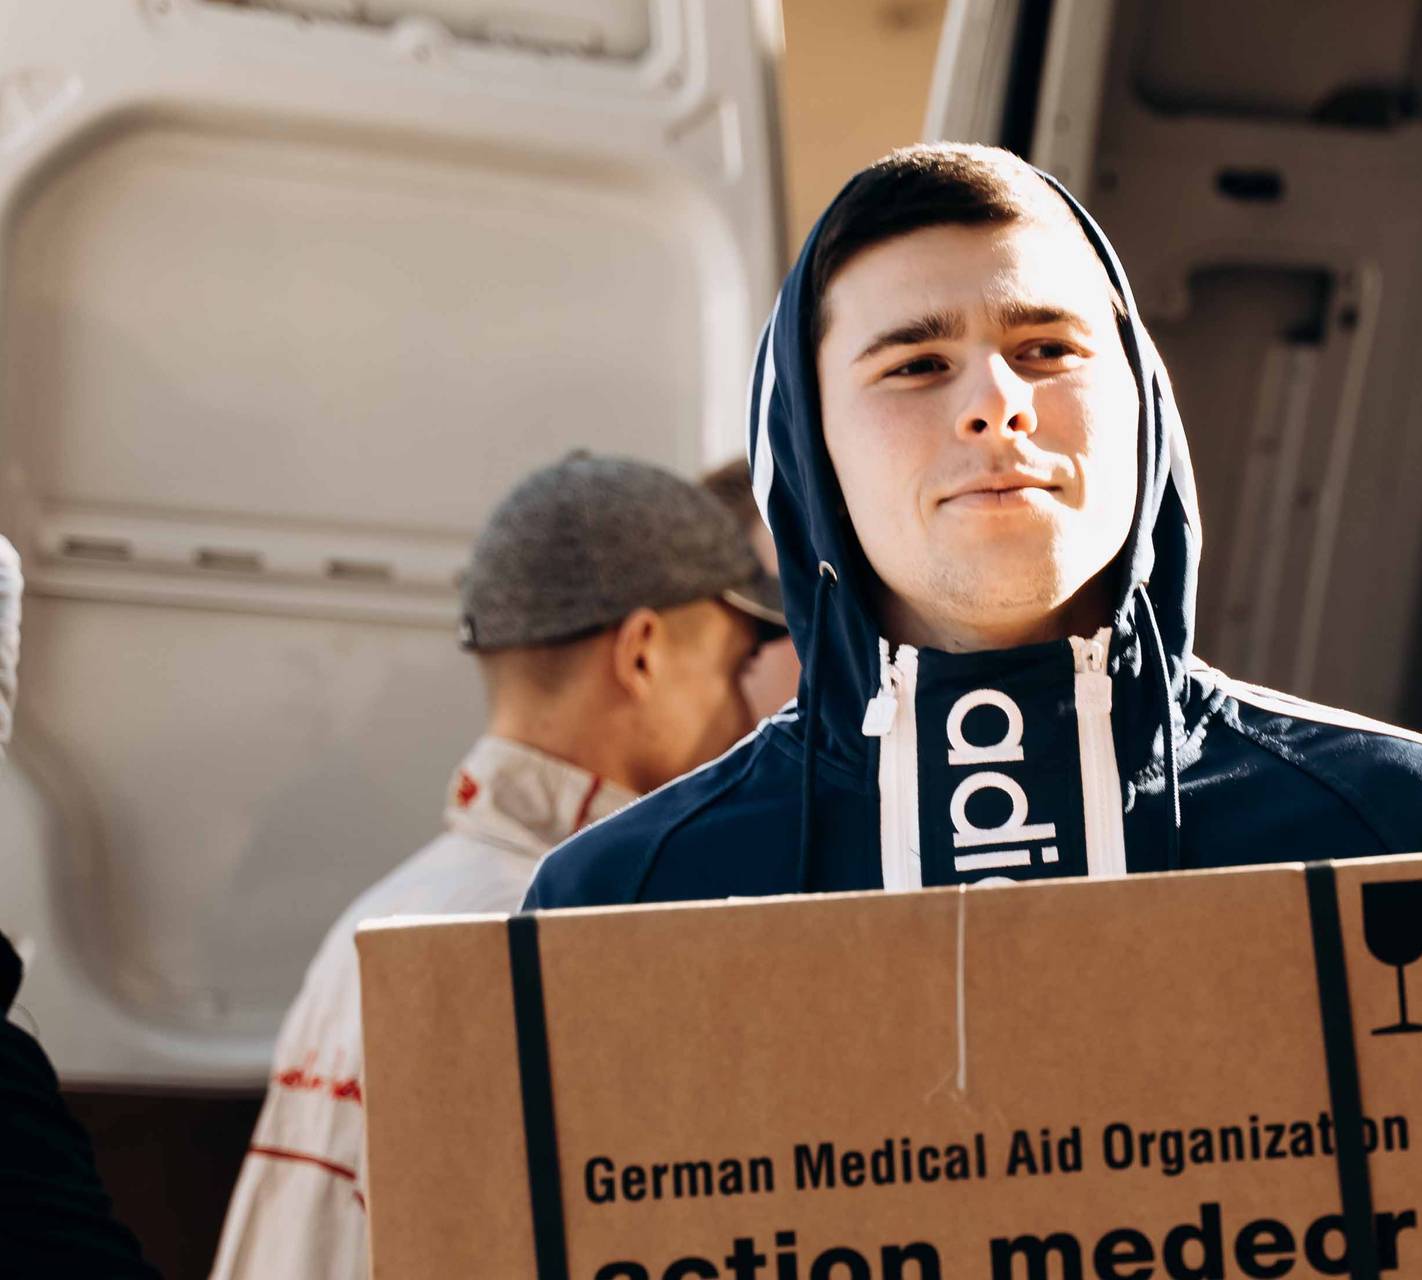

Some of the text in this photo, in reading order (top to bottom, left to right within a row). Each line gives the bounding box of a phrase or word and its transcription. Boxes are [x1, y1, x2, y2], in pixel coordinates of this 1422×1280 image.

[946, 688, 1060, 887] adi
[584, 1112, 1409, 1204] German Medical Aid Organizaton
[990, 1202, 1417, 1280] medeor
